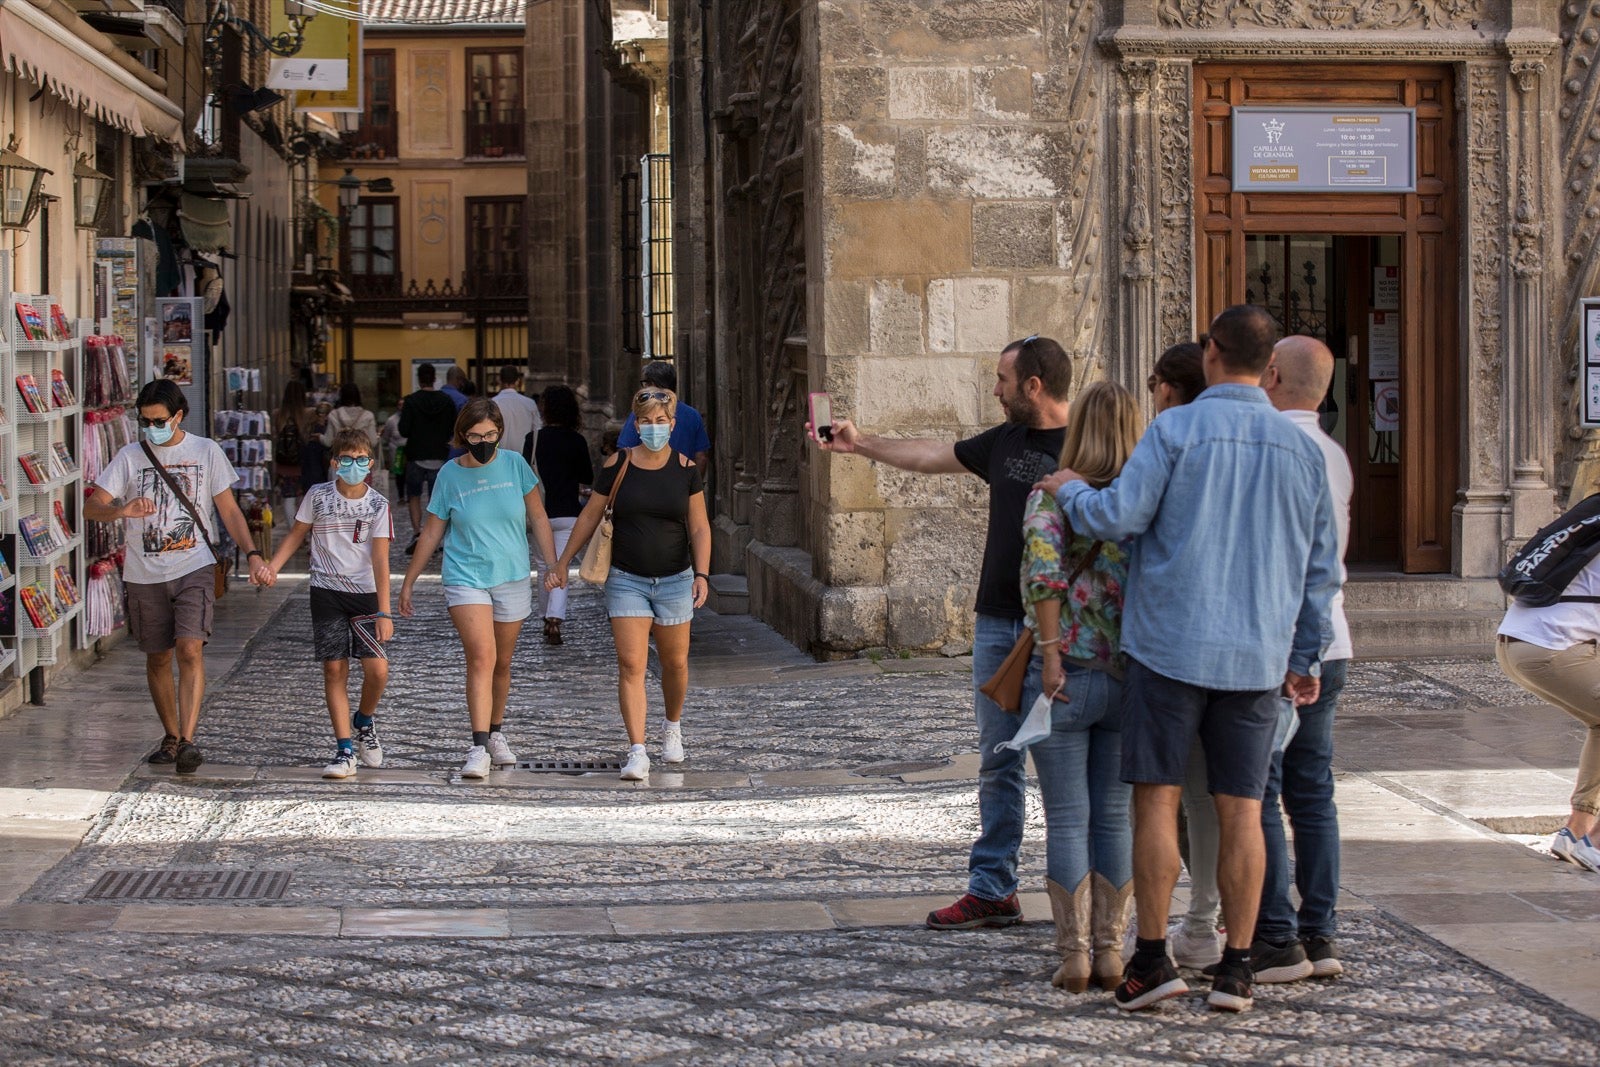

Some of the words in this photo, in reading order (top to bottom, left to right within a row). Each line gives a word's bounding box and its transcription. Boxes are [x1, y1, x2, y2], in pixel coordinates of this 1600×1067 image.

[1023, 449, 1042, 461] THE
[1004, 457, 1039, 472] NORTH
[1007, 468, 1034, 483] FACE
[1523, 514, 1600, 577] HARDCO
